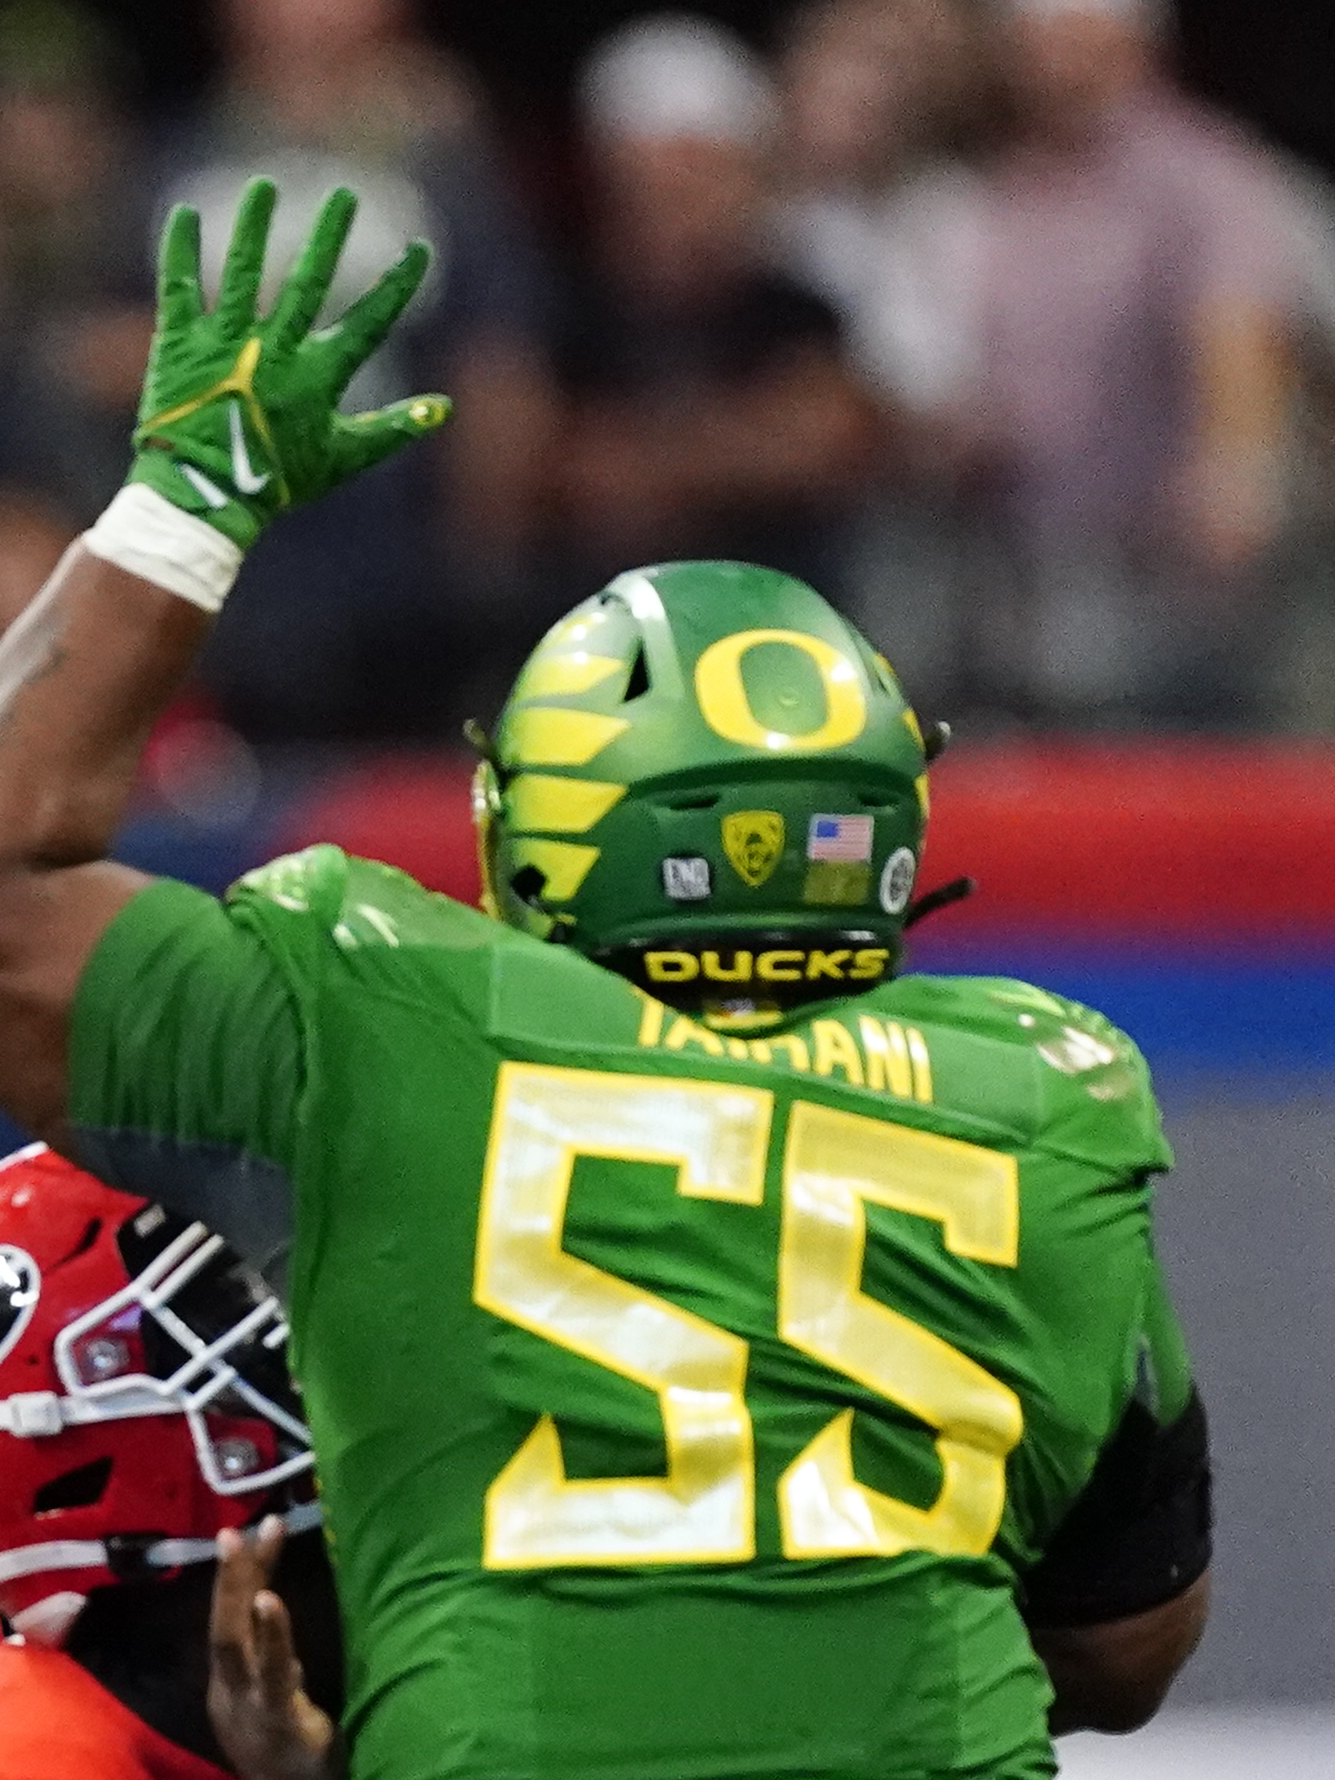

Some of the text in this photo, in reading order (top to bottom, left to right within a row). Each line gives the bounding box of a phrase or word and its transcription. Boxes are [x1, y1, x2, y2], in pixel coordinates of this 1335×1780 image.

[694, 627, 867, 751] O
[643, 948, 890, 982] DUCKS
[473, 1060, 1023, 1570] 55
